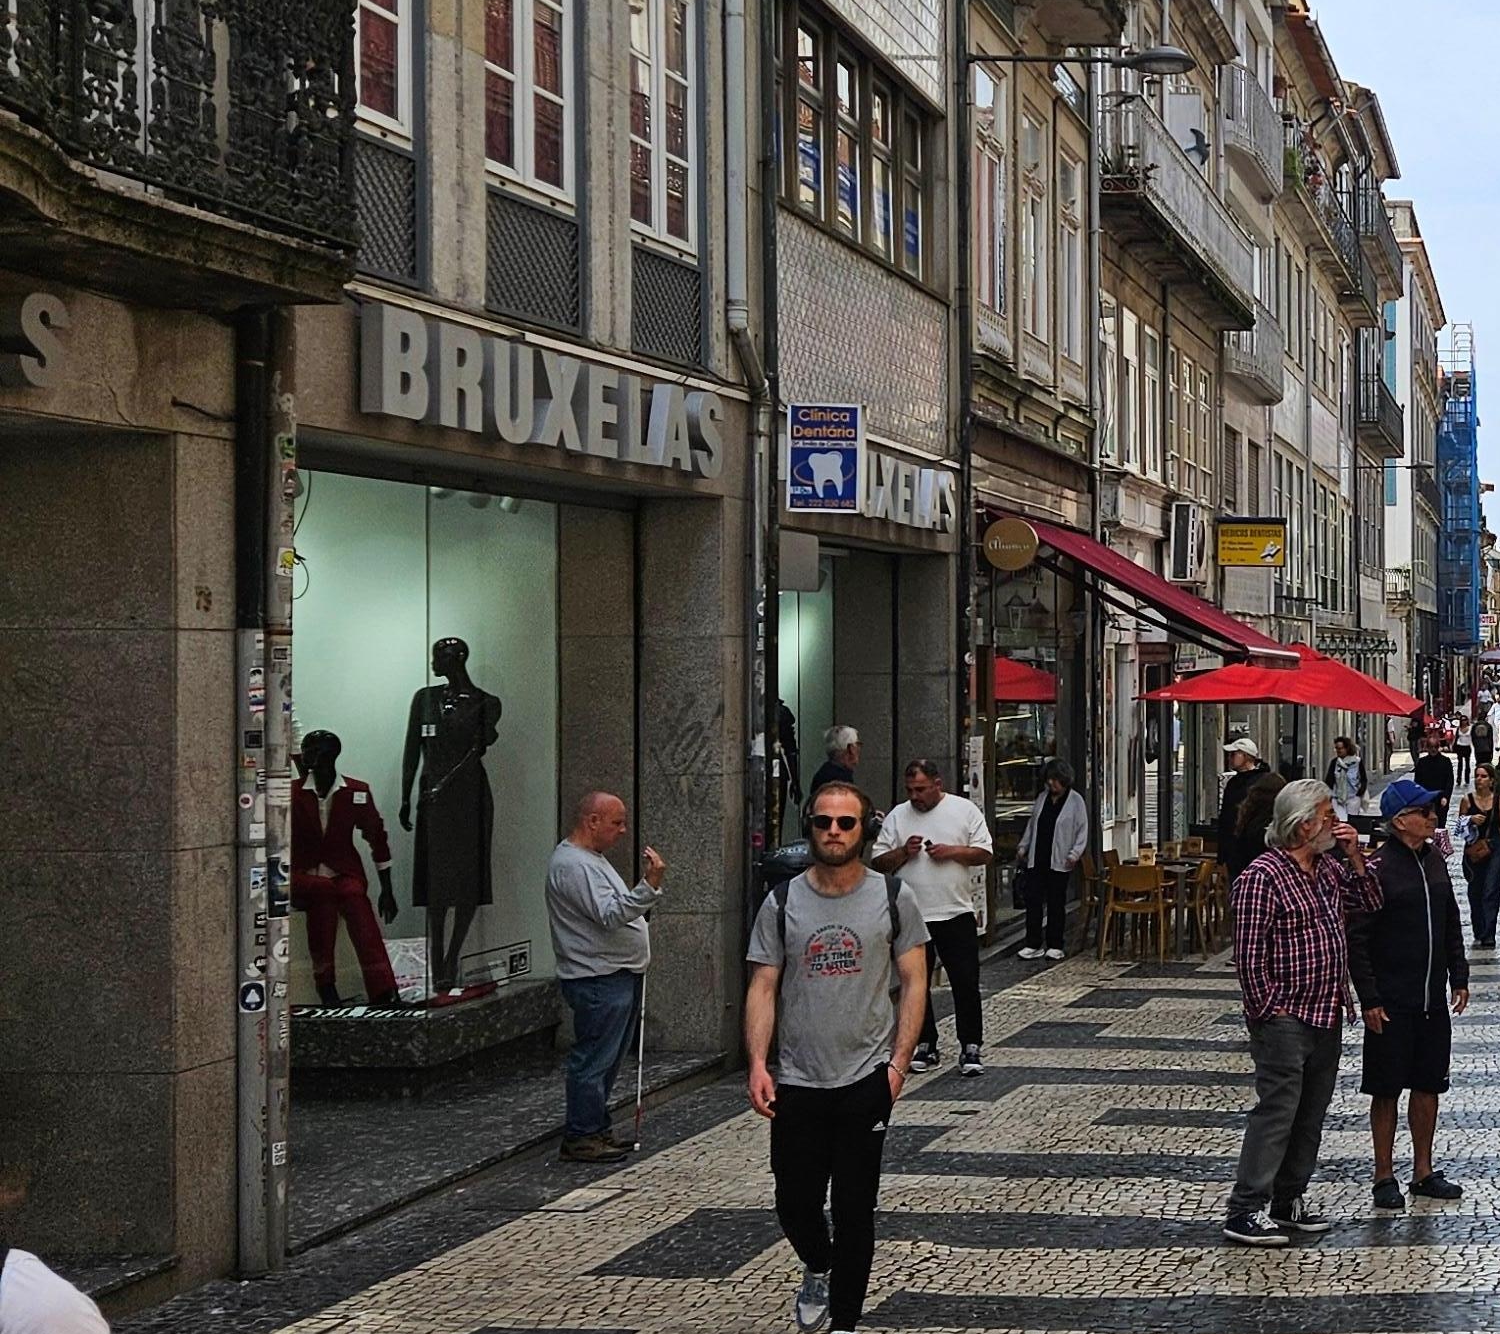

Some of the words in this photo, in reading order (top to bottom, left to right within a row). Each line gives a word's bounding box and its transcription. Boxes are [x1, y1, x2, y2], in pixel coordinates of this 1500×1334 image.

[20, 292, 68, 388] S
[362, 302, 723, 479] BRUXELAS
[798, 408, 850, 422] Clínica
[793, 425, 855, 438] Dentária
[832, 950, 854, 960] TIME
[811, 962, 823, 971] TO
